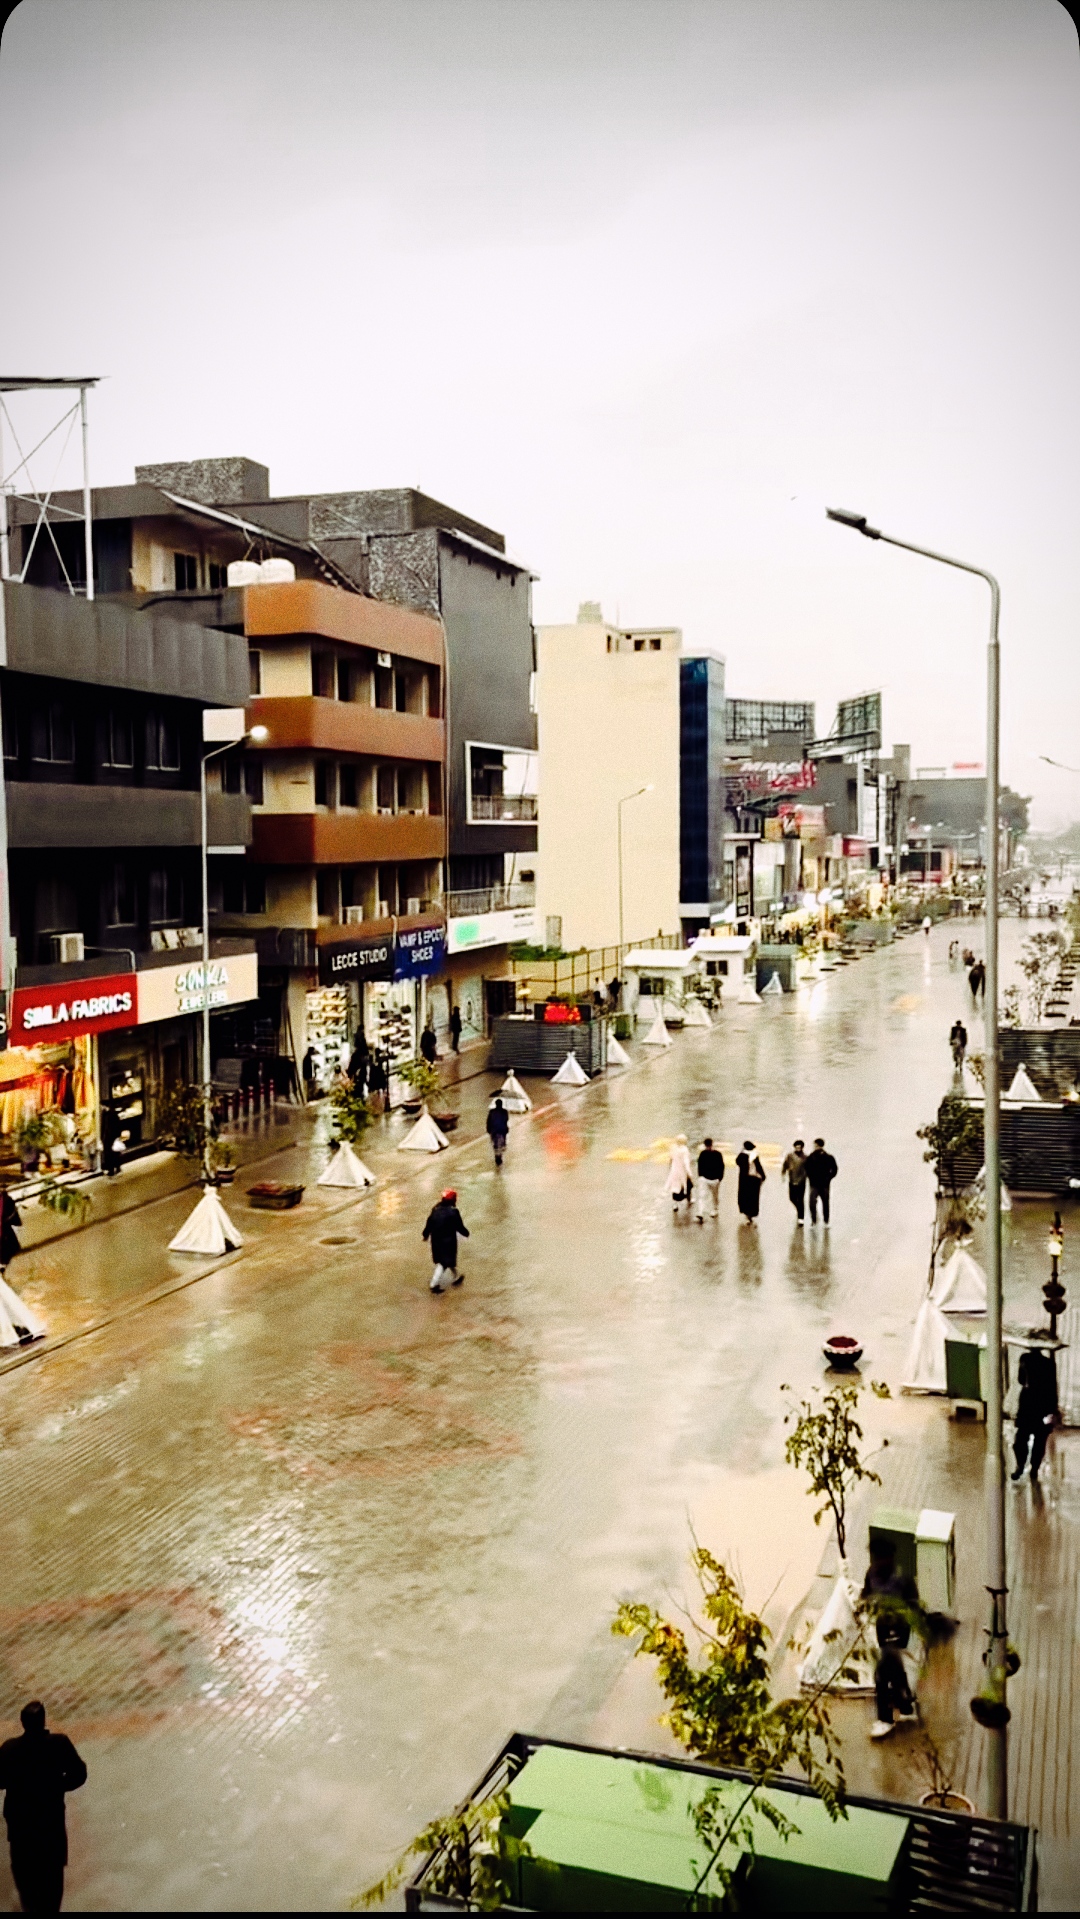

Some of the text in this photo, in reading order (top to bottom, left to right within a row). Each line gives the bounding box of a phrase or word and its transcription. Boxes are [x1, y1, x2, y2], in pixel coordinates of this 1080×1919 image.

[359, 948, 387, 965] STUDIO
[411, 946, 433, 963] SHOES
[71, 992, 132, 1019] FABRICS
